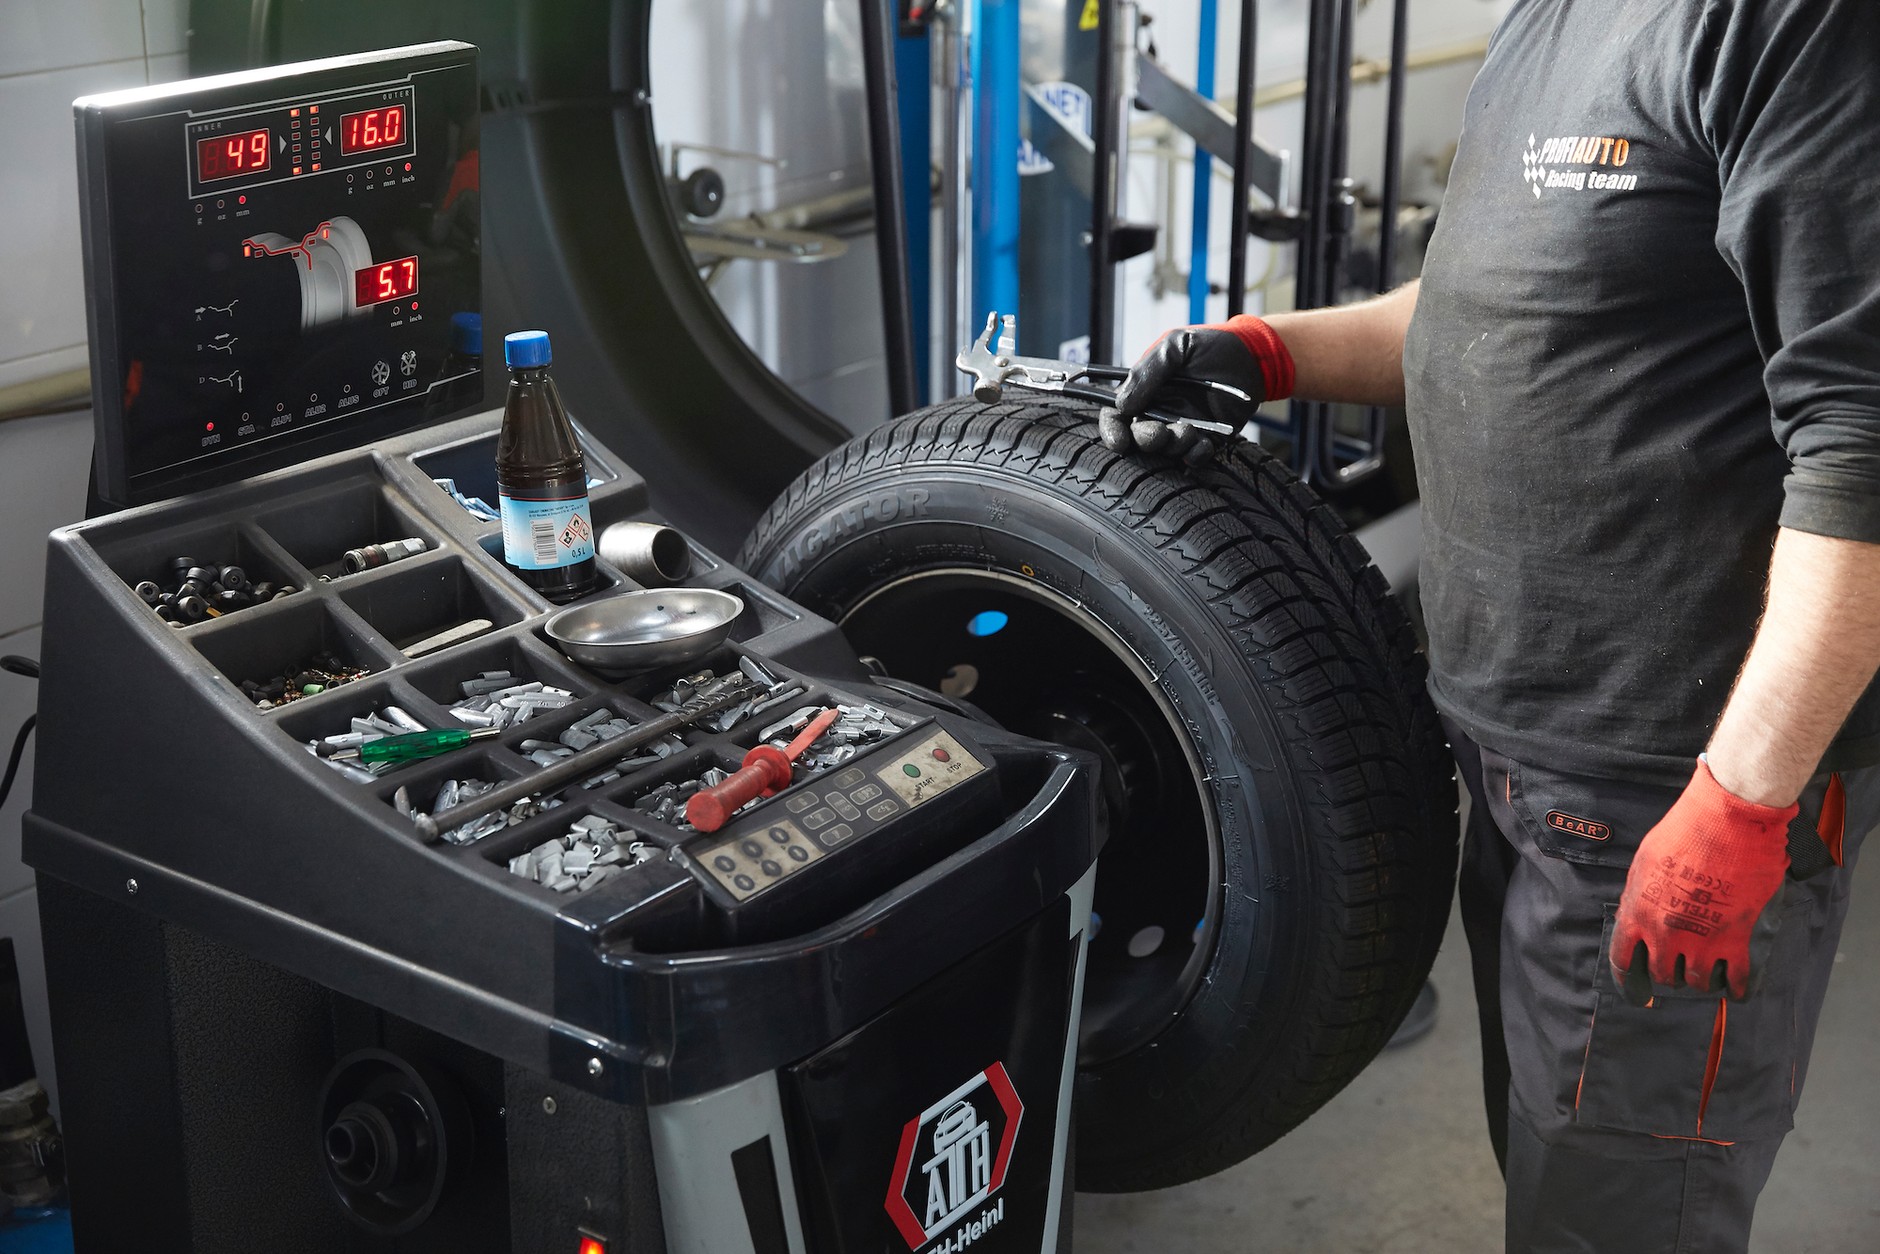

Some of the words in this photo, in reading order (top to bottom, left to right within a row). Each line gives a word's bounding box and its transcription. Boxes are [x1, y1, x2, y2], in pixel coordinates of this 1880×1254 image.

[382, 90, 411, 101] OUTER
[191, 122, 222, 133] INNER
[351, 110, 400, 146] 16.0
[227, 133, 267, 168] 49
[1537, 136, 1630, 167] PROFIAUTO
[383, 179, 396, 188] mm
[401, 174, 416, 184] inch
[1544, 169, 1586, 191] Racing
[1587, 171, 1638, 191] team
[379, 261, 414, 298] 5.7
[409, 313, 423, 323] inch
[201, 433, 221, 448] DYN
[237, 423, 256, 437] STA
[270, 413, 293, 428] ALU1
[304, 403, 327, 418] ALU2
[765, 488, 931, 591] VIGATOR
[571, 548, 581, 559] 0,5
[947, 762, 962, 774] STOP
[914, 776, 935, 791] START
[1555, 816, 1597, 835] BeAR
[922, 1120, 990, 1229] ATH
[927, 1197, 1004, 1254] H-Heinl
